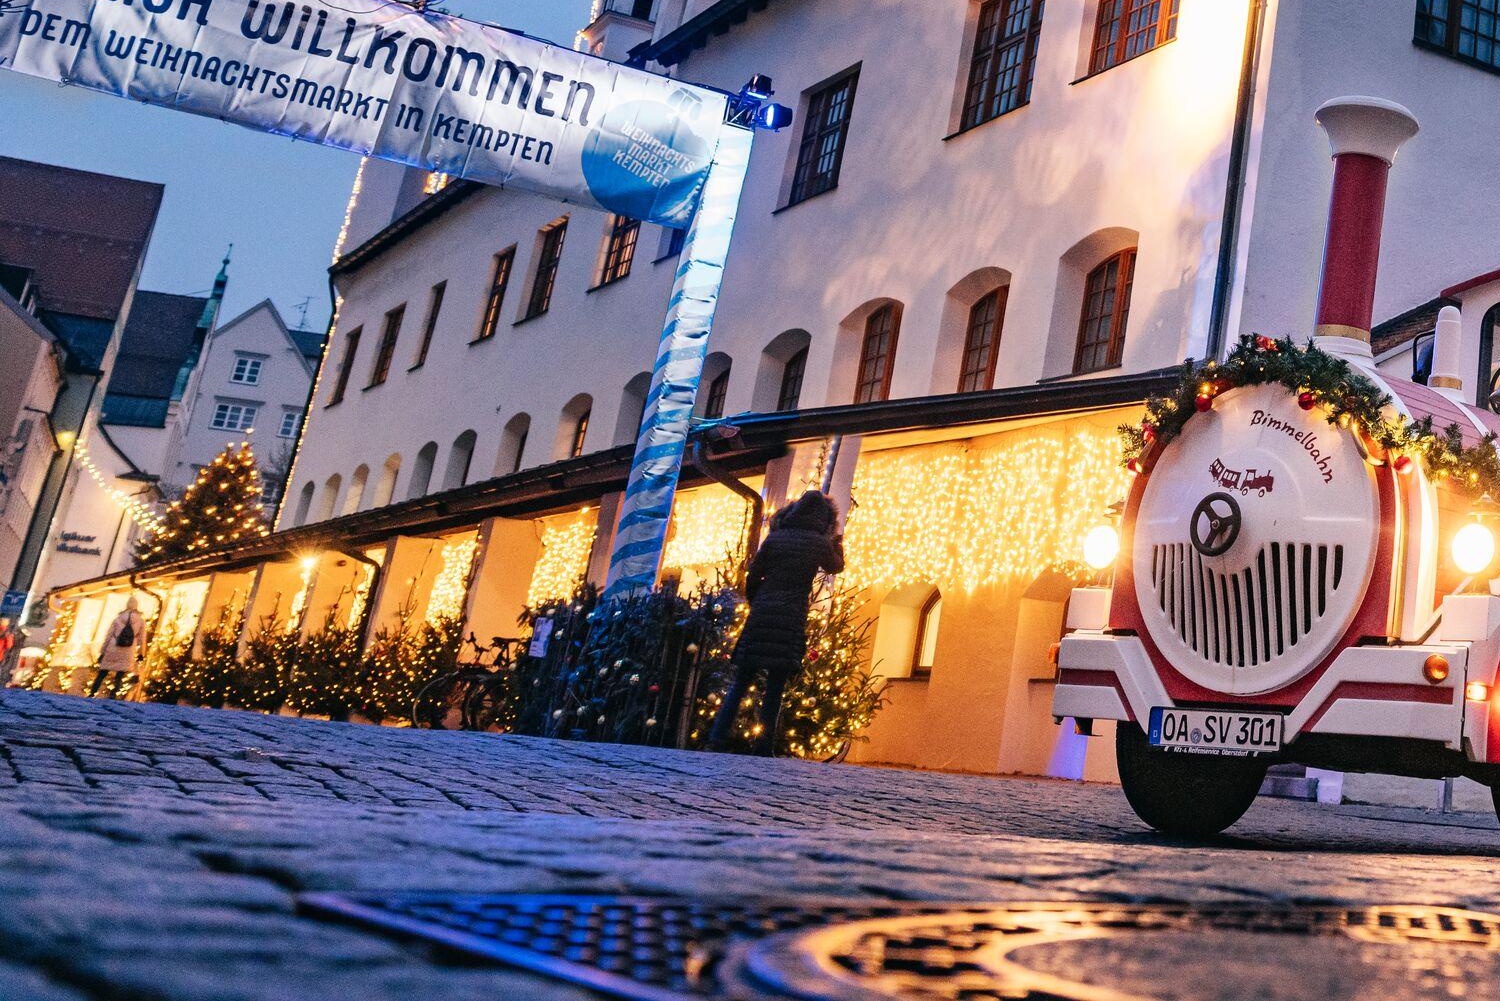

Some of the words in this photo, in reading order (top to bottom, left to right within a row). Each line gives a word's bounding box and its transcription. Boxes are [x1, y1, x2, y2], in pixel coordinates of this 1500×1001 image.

[19, 7, 92, 50] DEM
[104, 29, 390, 122] WEIHNACHTSMARKT
[395, 103, 424, 133] IN
[432, 112, 555, 166] KEMPTEN
[620, 120, 696, 174] WEIHNACHTS
[627, 142, 673, 176] MARKT
[1249, 409, 1334, 484] Bimmelbahn
[1162, 712, 1189, 742] OA
[1203, 715, 1233, 744] SV
[1236, 716, 1277, 747] 301
